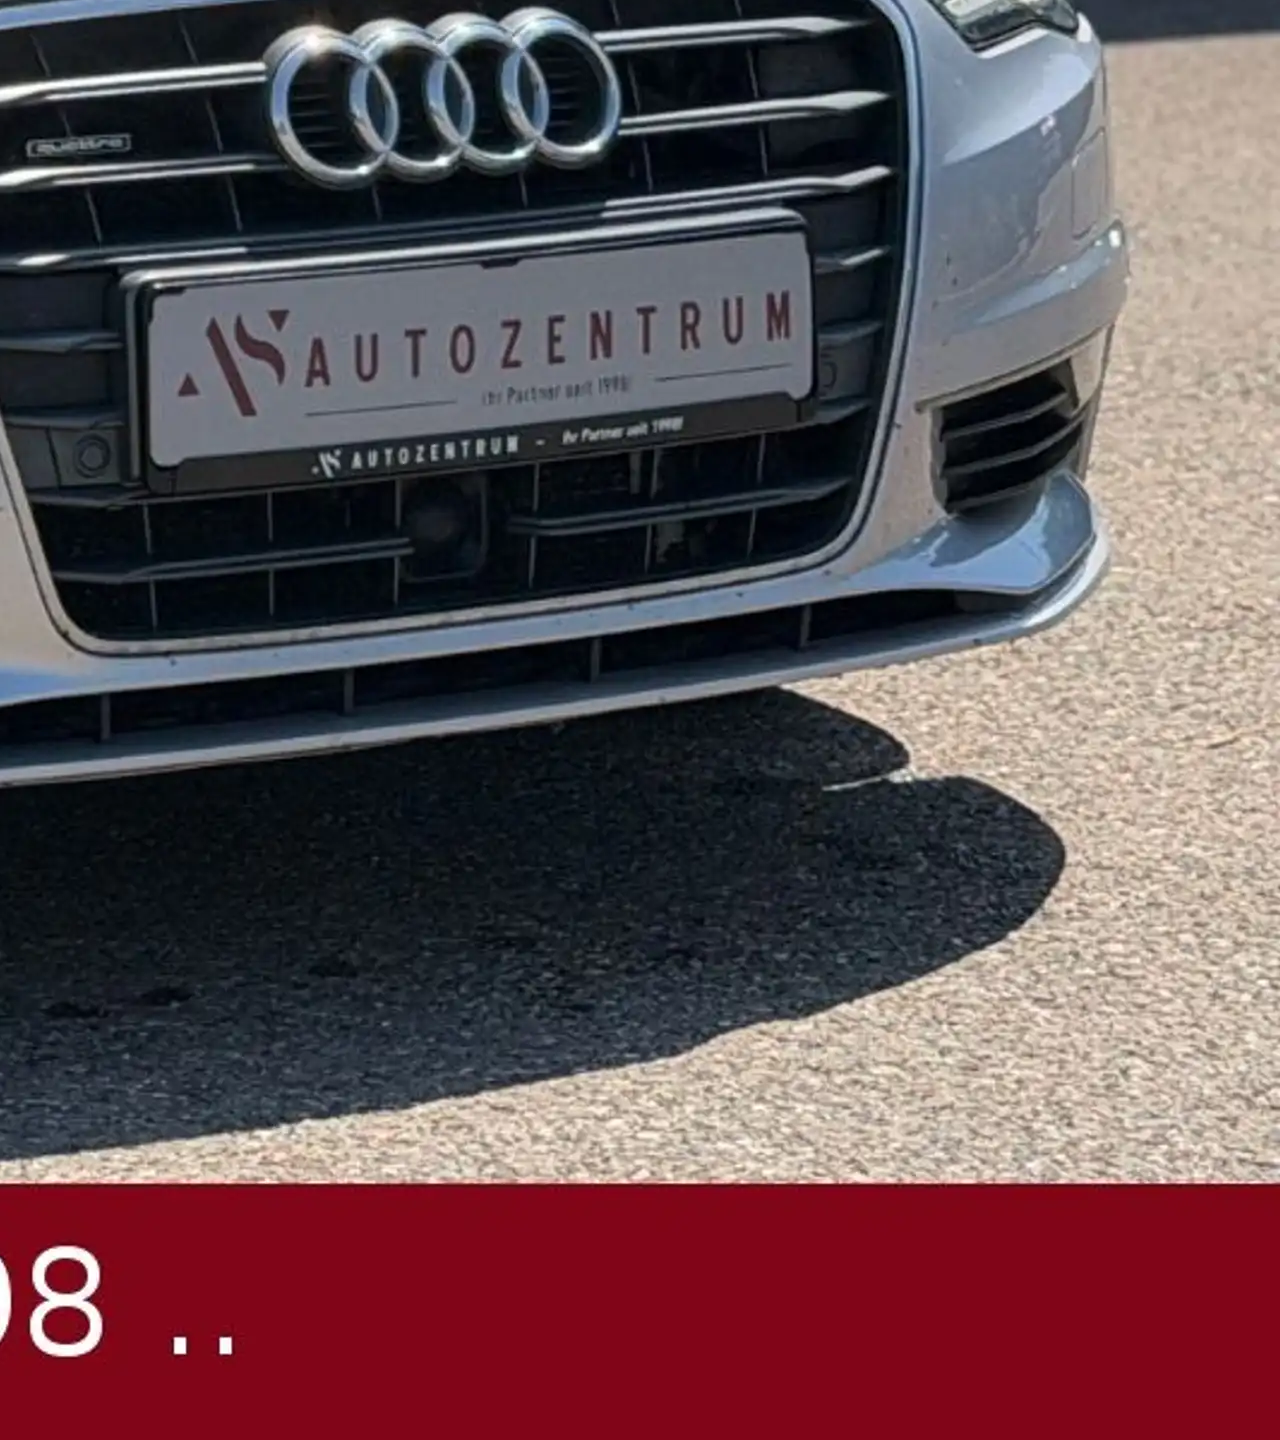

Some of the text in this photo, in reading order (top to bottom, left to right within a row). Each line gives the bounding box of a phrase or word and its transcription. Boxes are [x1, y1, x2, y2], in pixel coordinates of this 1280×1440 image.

[304, 290, 793, 389] AUTOZENTRUM
[506, 385, 561, 405] Partner
[351, 435, 520, 470] AUTOZENTRUM
[581, 426, 625, 443] Partner
